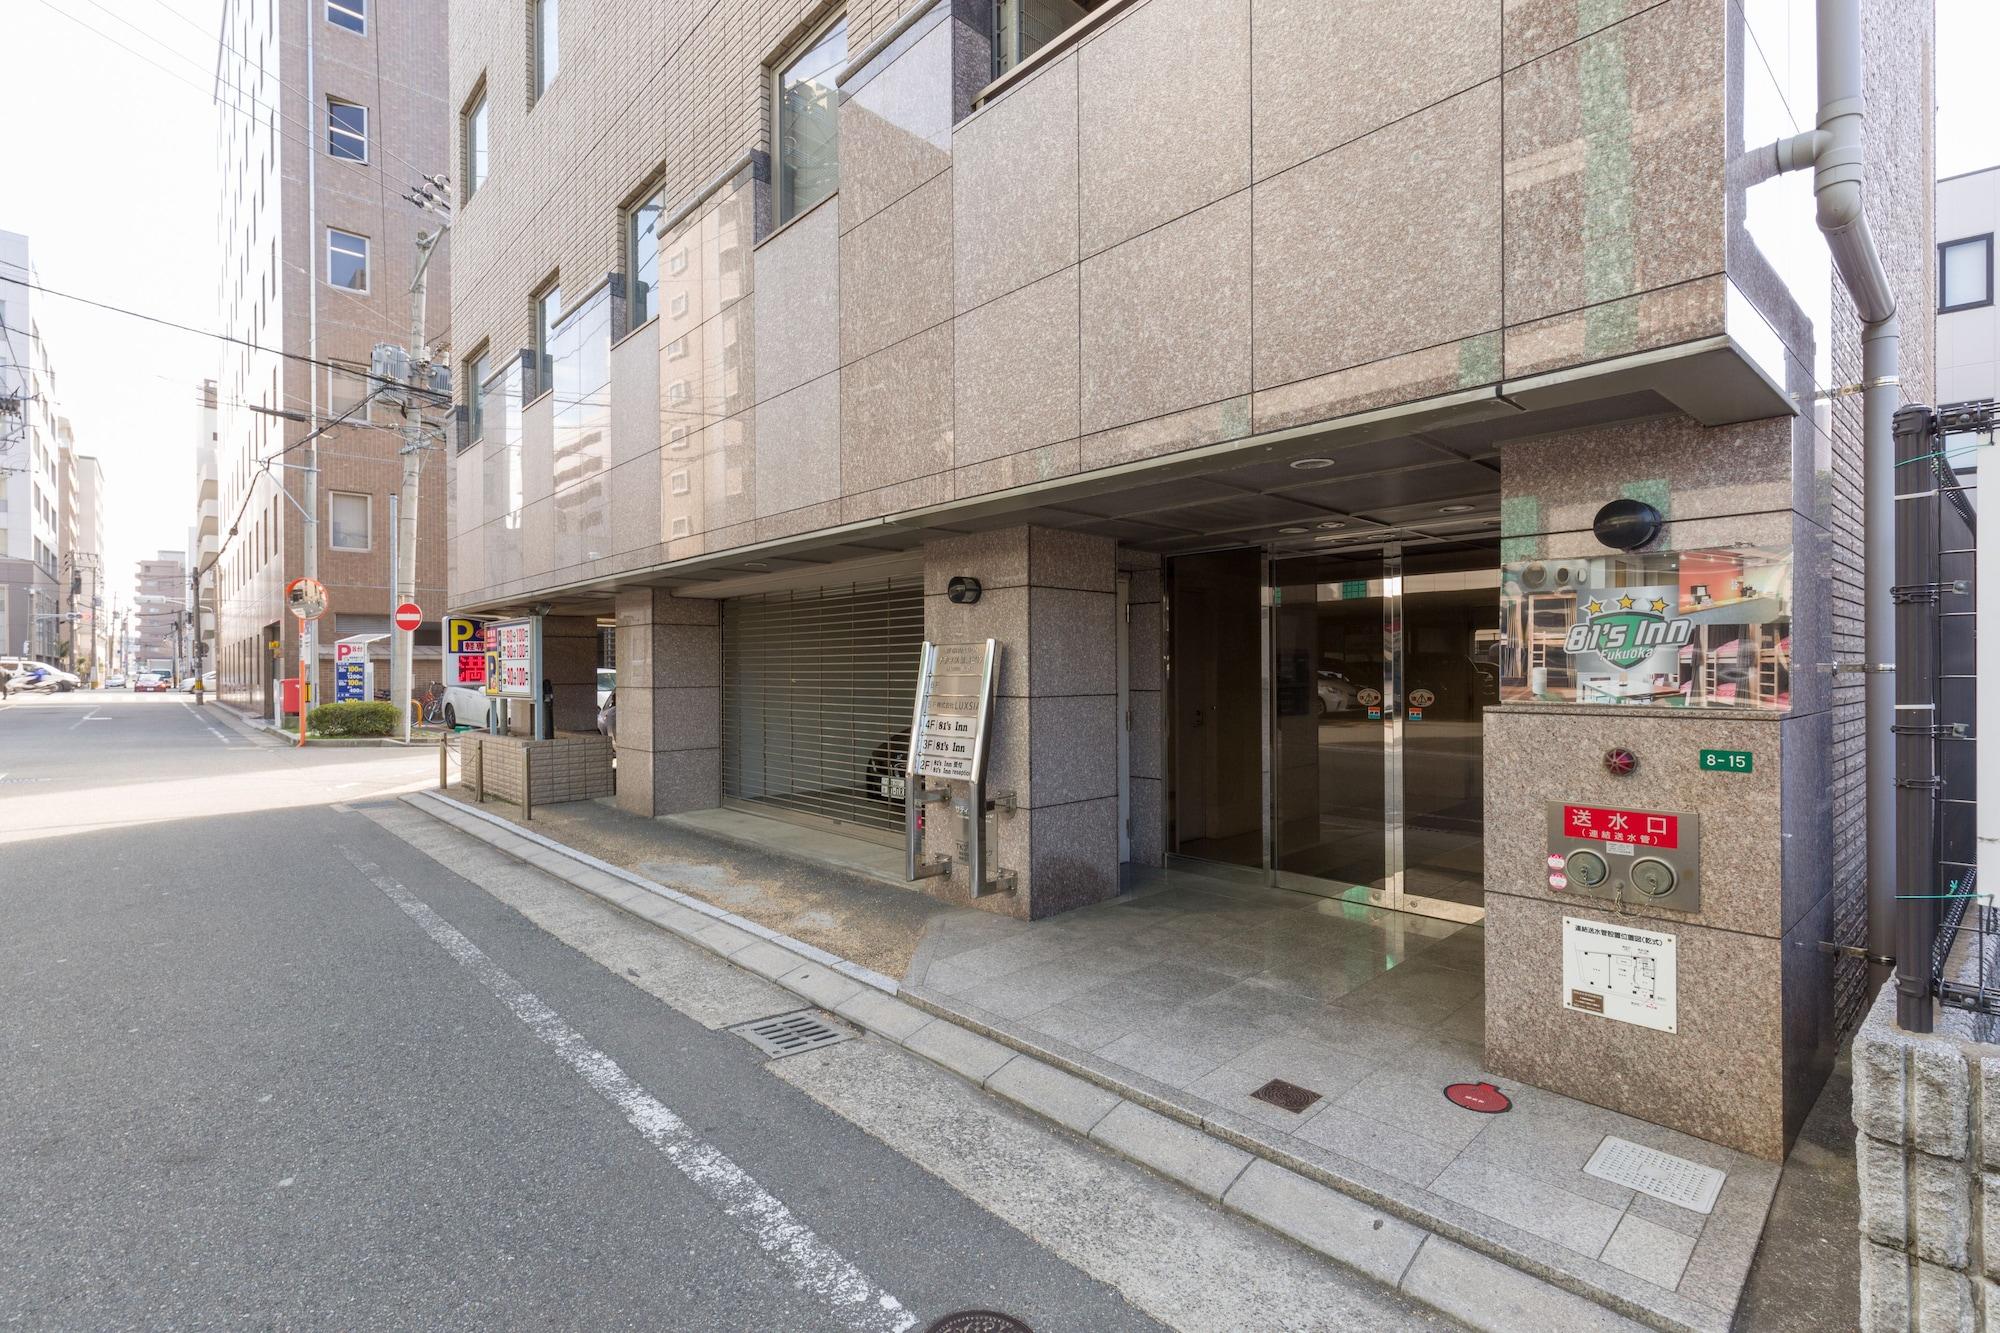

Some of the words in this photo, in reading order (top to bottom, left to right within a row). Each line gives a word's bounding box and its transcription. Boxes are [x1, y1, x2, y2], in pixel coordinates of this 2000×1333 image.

[450, 619, 474, 652] P
[1567, 623, 1628, 652] 81's
[1634, 619, 1691, 646] Inn
[338, 644, 351, 661] P
[1599, 646, 1654, 663] Fukuoka
[925, 719, 935, 730] 4F
[955, 722, 968, 732] Inn
[923, 739, 933, 749] 3F
[952, 742, 965, 752] Inn
[920, 760, 930, 770] 2F
[1706, 753, 1747, 769] 8-15
[1571, 809, 1668, 836] 送水口
